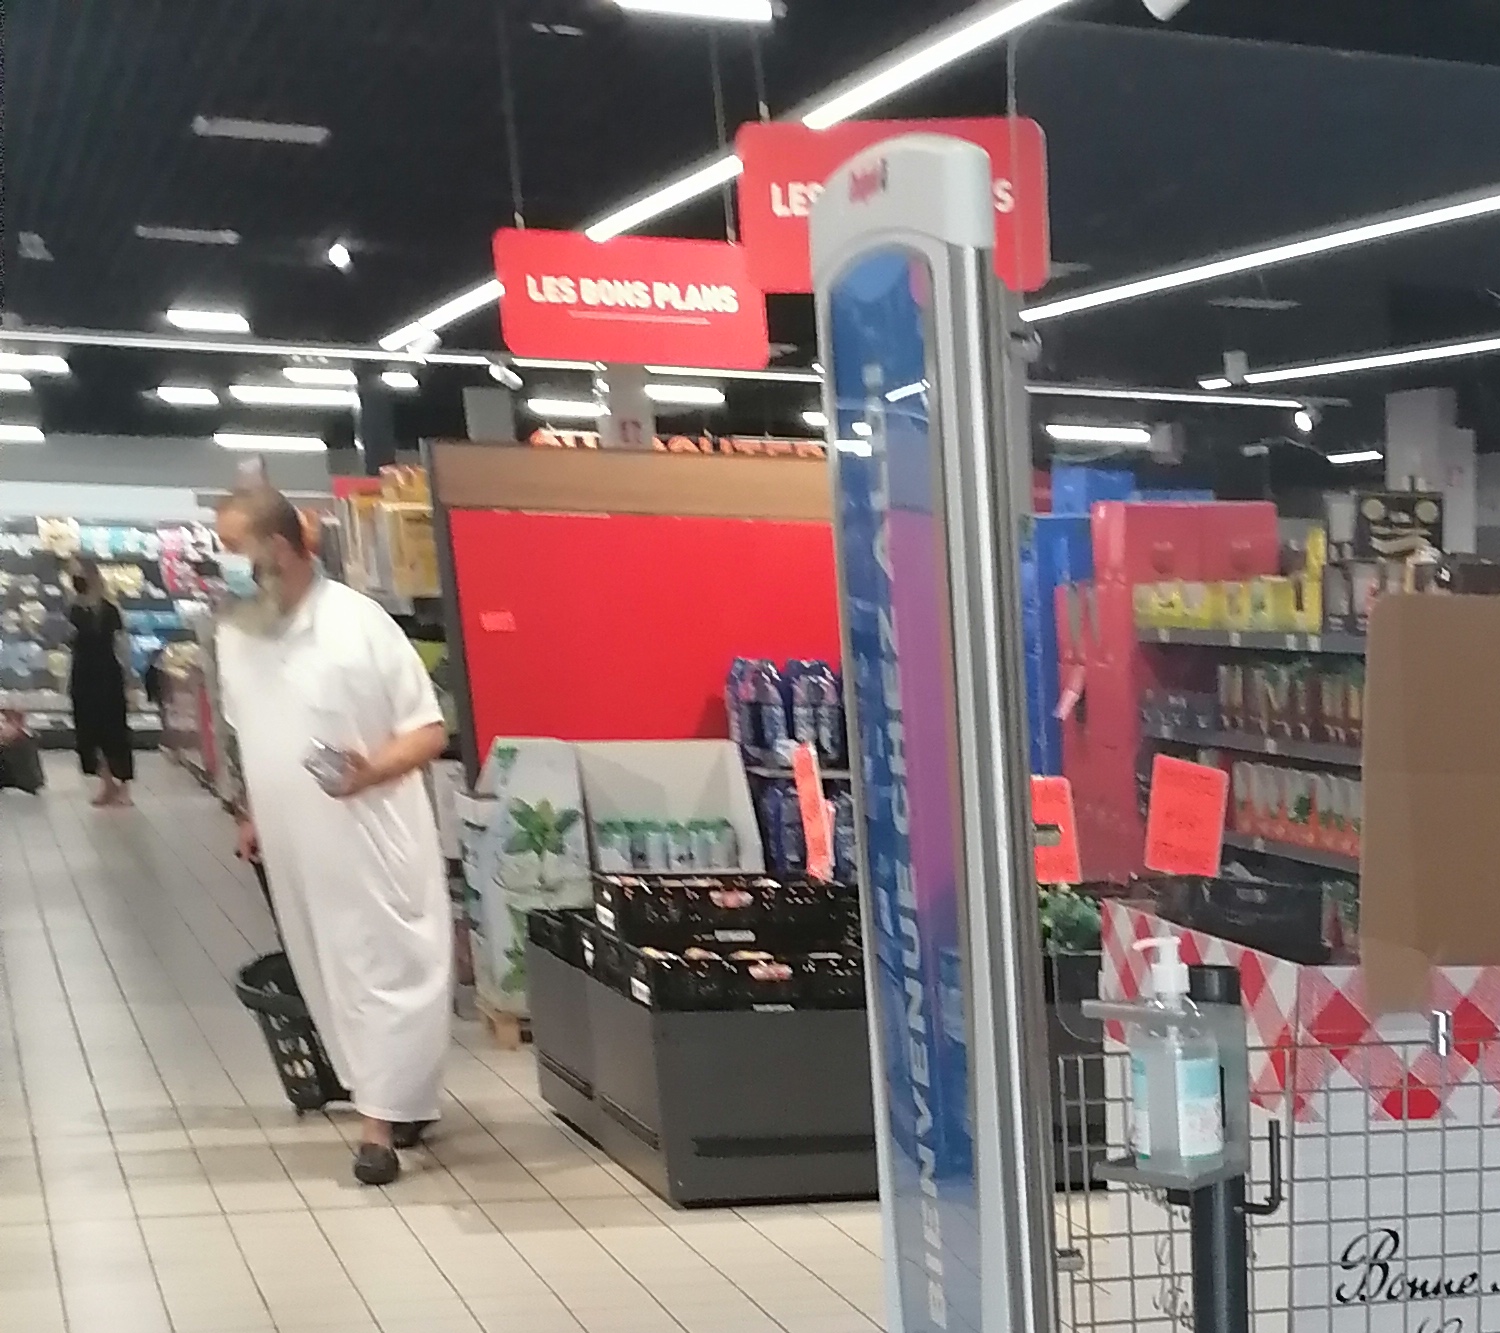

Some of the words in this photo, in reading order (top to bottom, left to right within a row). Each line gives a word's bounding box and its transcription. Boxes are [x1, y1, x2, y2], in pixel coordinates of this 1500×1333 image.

[525, 274, 578, 305] LES
[580, 277, 652, 310] BONS
[652, 281, 740, 314] PLANS
[877, 601, 911, 834] CHEZ
[895, 856, 948, 1330] BIENVENUE
[1335, 1227, 1480, 1304] Bonne
